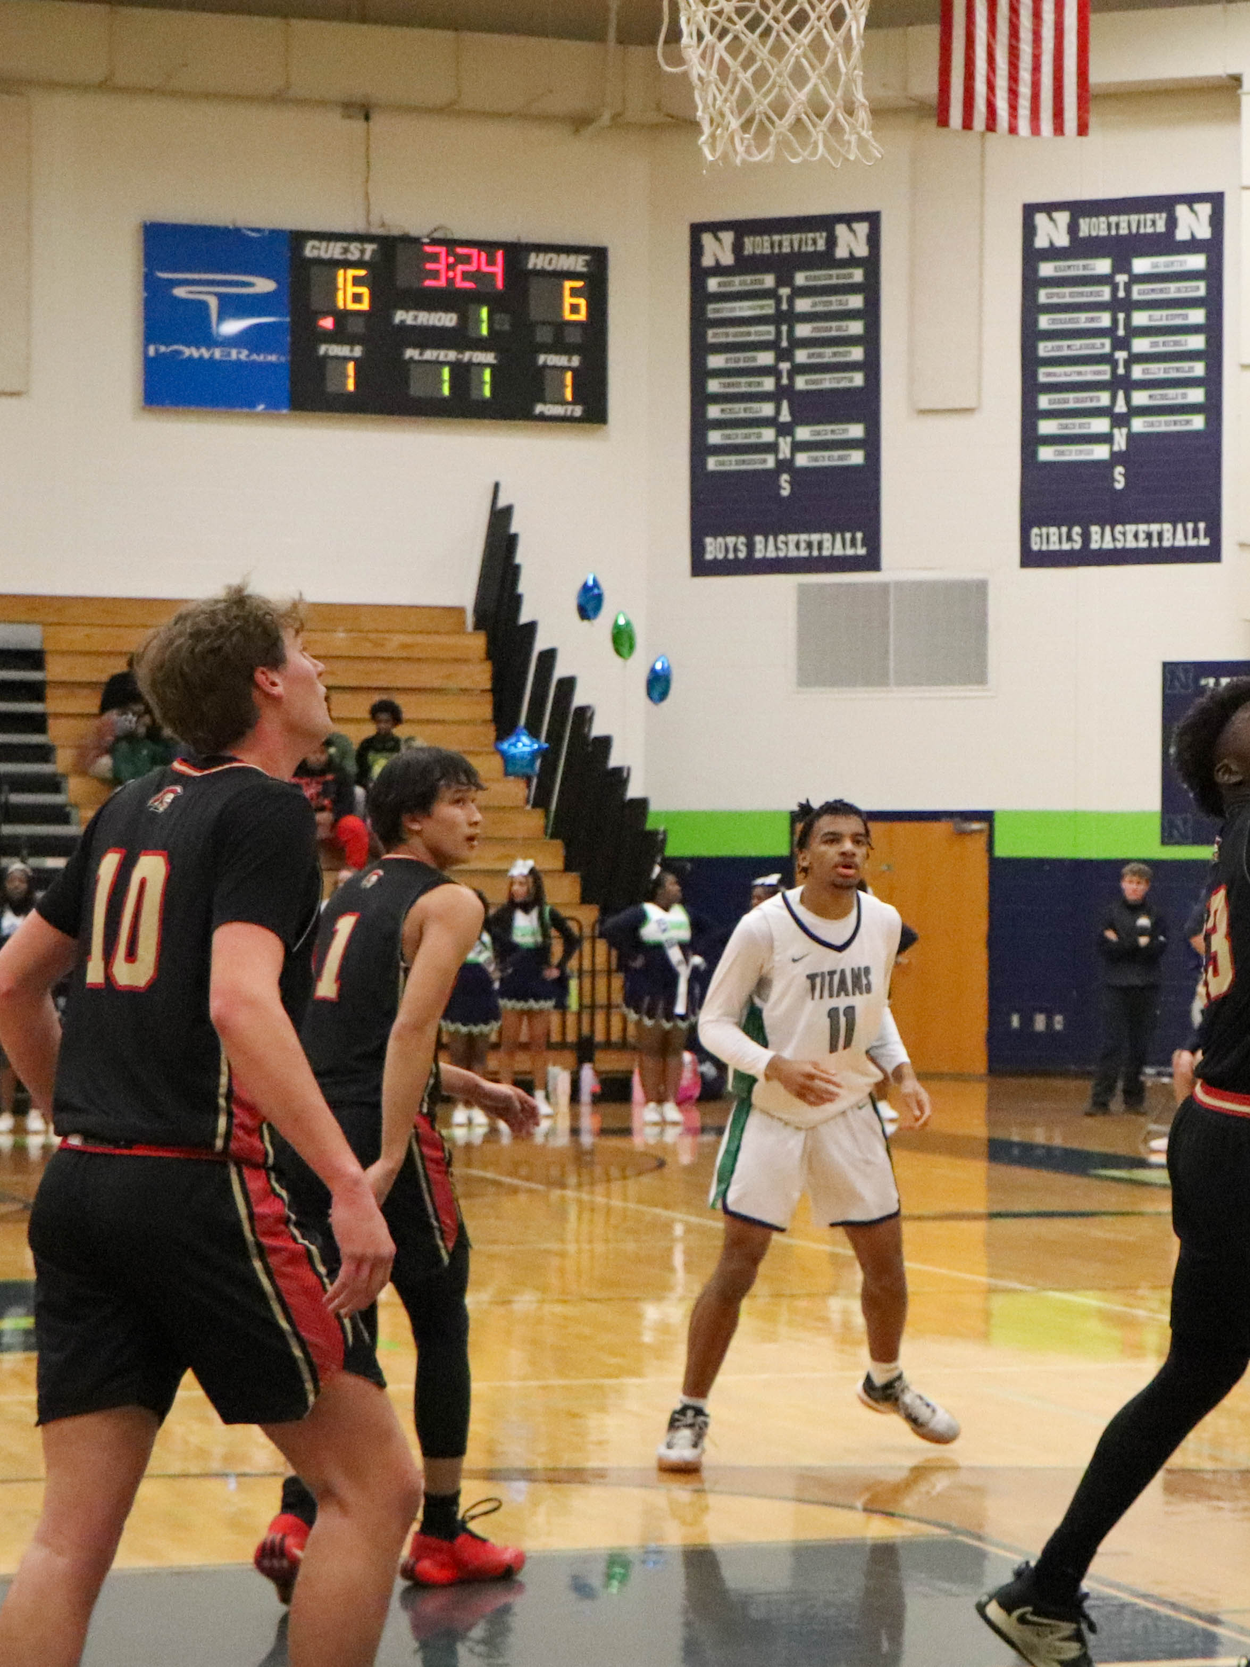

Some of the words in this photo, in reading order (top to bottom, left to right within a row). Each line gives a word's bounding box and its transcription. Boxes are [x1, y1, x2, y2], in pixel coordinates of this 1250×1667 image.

[1034, 211, 1070, 248] N
[1078, 213, 1167, 237] NORTHVIEW
[1175, 202, 1212, 241] N
[304, 239, 377, 261] GUEST
[701, 231, 735, 267] N
[743, 232, 827, 255] NORTHVIEW
[835, 222, 869, 259] N
[422, 244, 504, 290] 3:24
[527, 252, 590, 272] HOME
[337, 267, 370, 311] 16
[562, 280, 587, 322] 6
[393, 310, 457, 328] PERIOD
[479, 305, 489, 337] 1
[317, 343, 363, 358] FOULS
[404, 347, 498, 365] PLAYER-FOUL
[537, 353, 581, 368] FOULS
[346, 360, 355, 392] 1
[563, 370, 573, 402] 1
[533, 403, 583, 418] POINTS
[704, 536, 748, 560] BOYS
[754, 532, 867, 559] BASKETBALL
[1030, 526, 1082, 551] GIRLS
[1090, 522, 1210, 550] BASKETBALL
[86, 847, 171, 992] 10
[314, 911, 361, 1002] 1
[806, 966, 872, 1000] TITANS
[828, 1005, 856, 1054] 11
